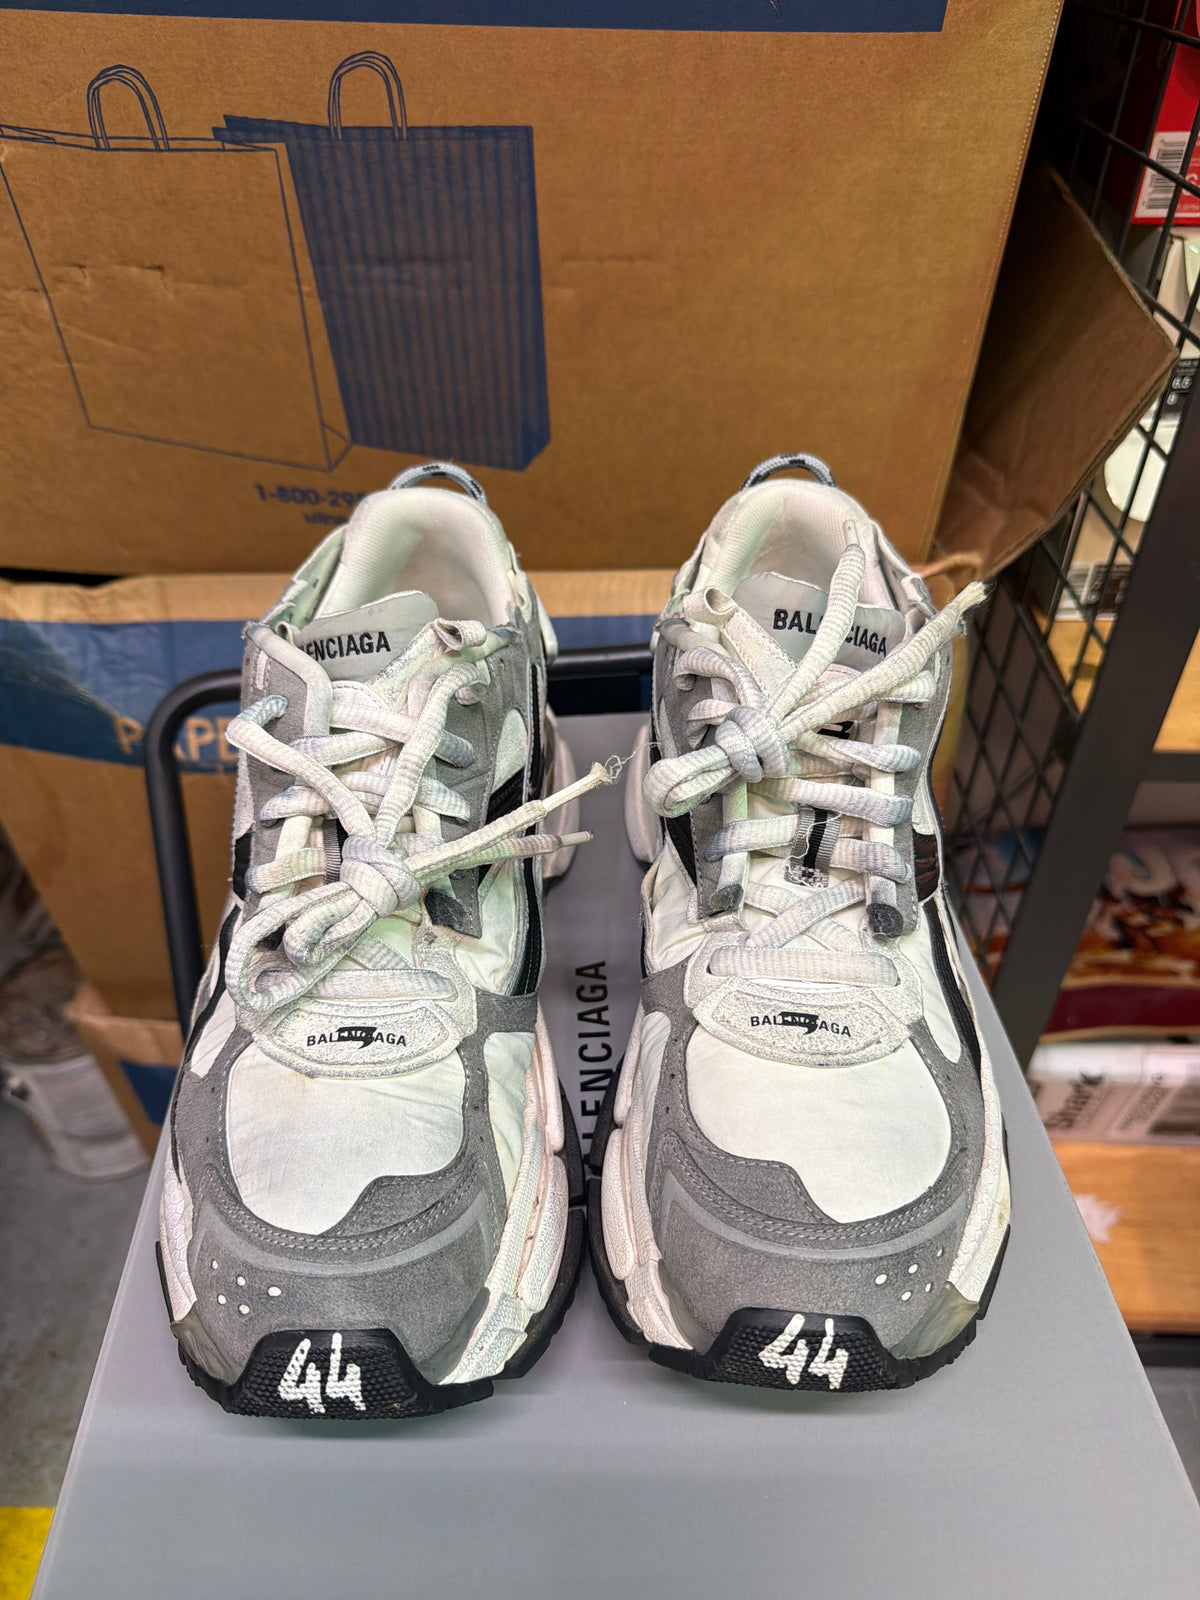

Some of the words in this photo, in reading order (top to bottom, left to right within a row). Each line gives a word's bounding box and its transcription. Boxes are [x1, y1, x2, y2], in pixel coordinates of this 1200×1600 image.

[253, 483, 365, 508] 1-800-29
[772, 608, 888, 658] BALIAGA
[113, 716, 240, 762] PPE
[306, 1026, 407, 1050] BALENCAGA
[749, 1011, 851, 1038] BALENCAGA
[277, 1332, 367, 1415] 44
[757, 1313, 849, 1390] 44
